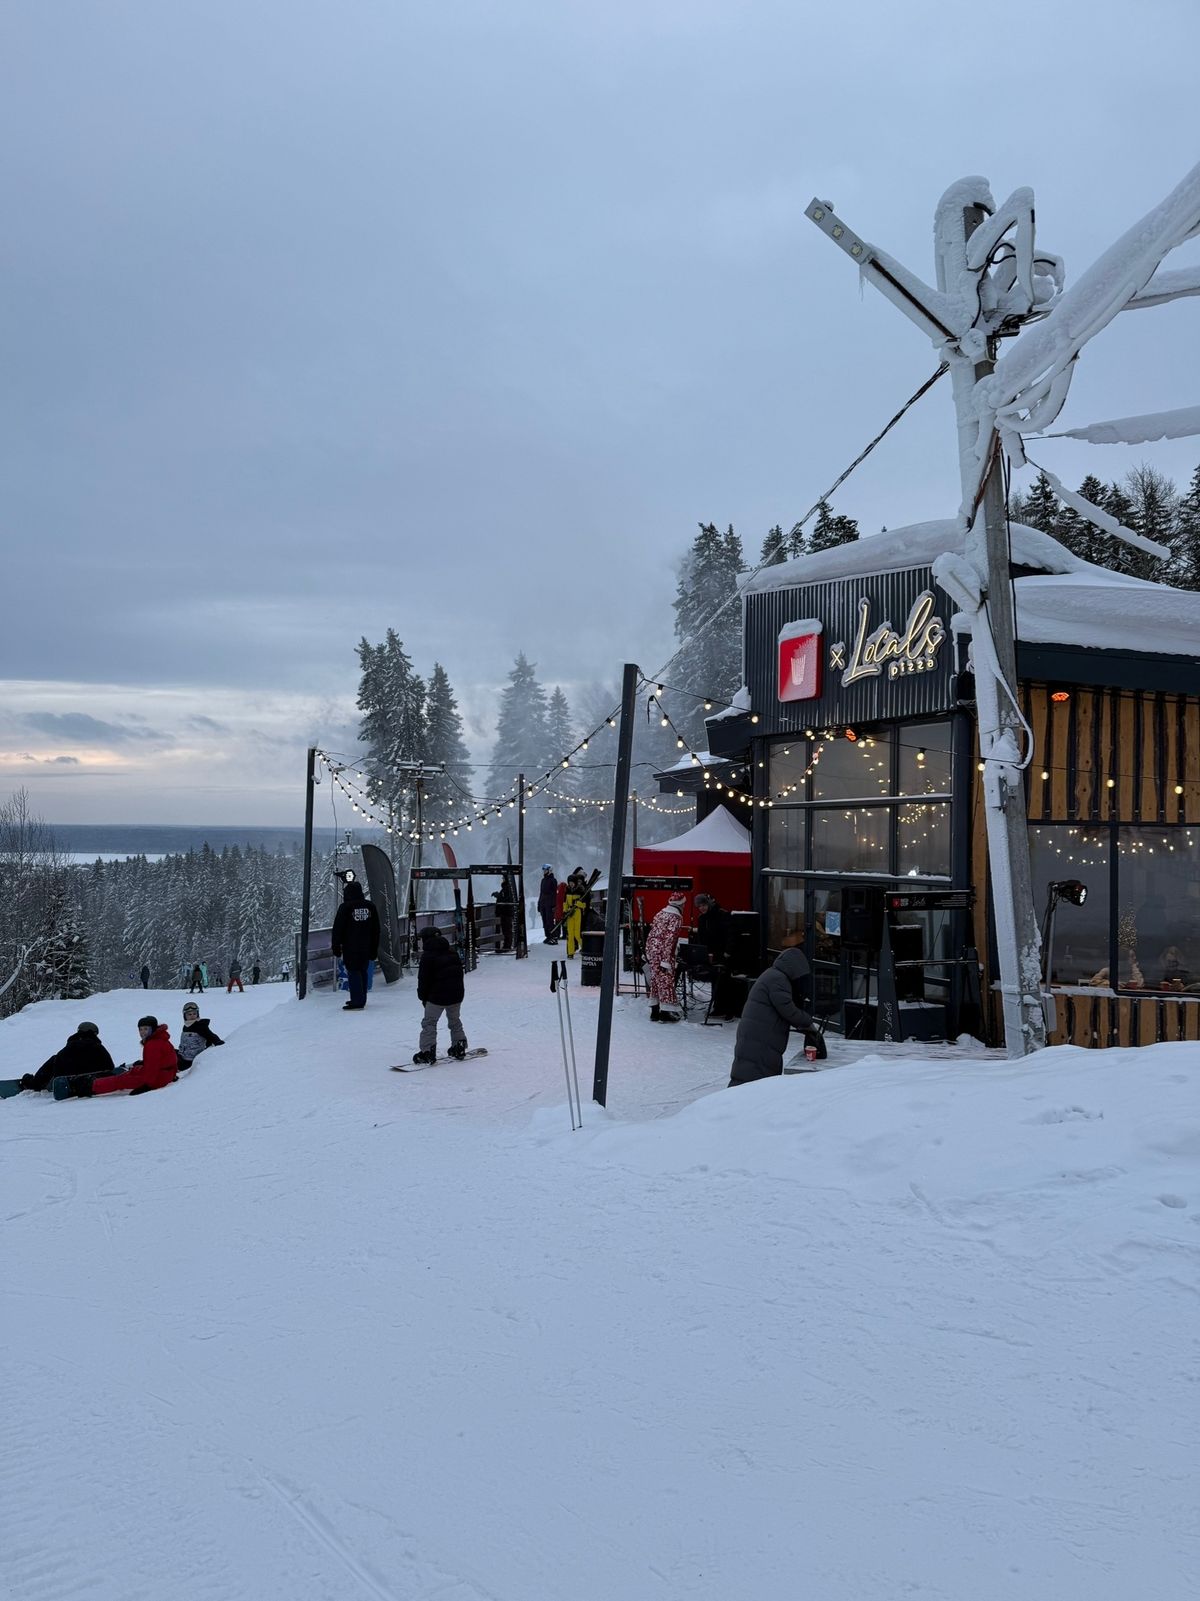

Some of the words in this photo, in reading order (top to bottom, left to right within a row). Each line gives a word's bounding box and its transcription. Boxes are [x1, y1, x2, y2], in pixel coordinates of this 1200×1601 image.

[843, 596, 943, 684] Locals
[890, 658, 935, 677] pizza
[354, 914, 369, 922] CUP
